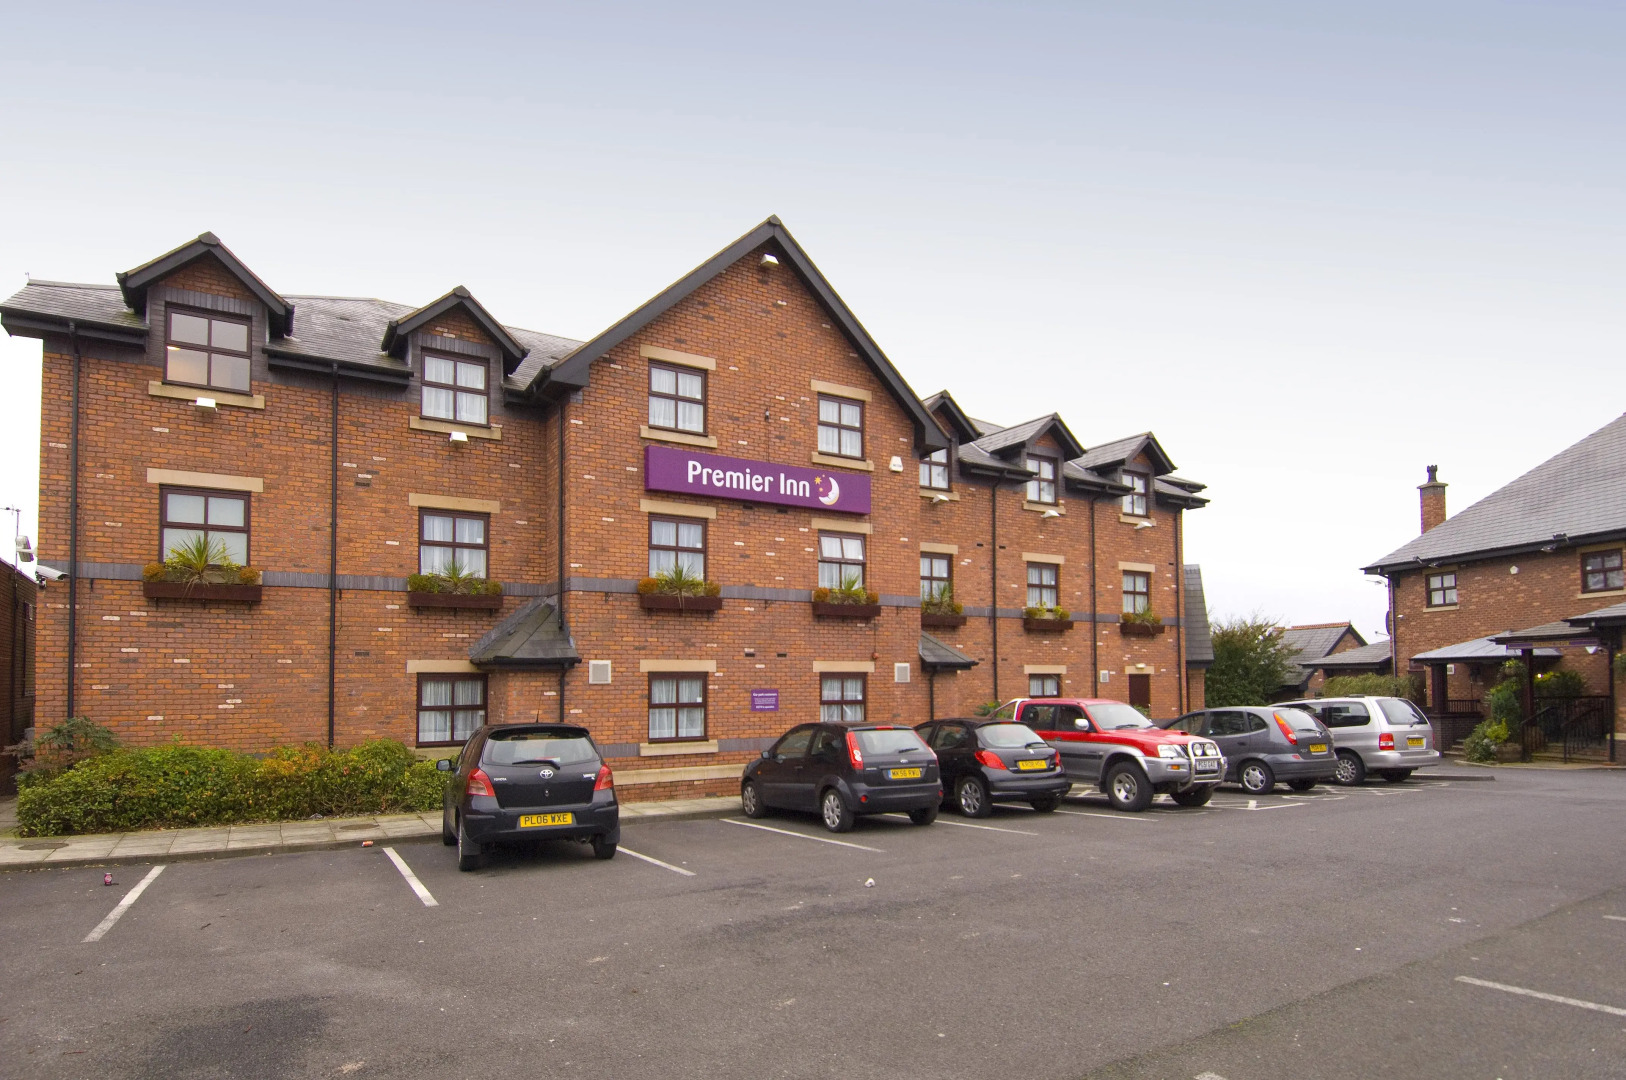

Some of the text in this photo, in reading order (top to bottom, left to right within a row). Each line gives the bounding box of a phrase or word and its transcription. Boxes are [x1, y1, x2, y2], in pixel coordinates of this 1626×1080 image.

[687, 460, 810, 498] Premier Inn
[524, 813, 568, 825] PL06 WXE
